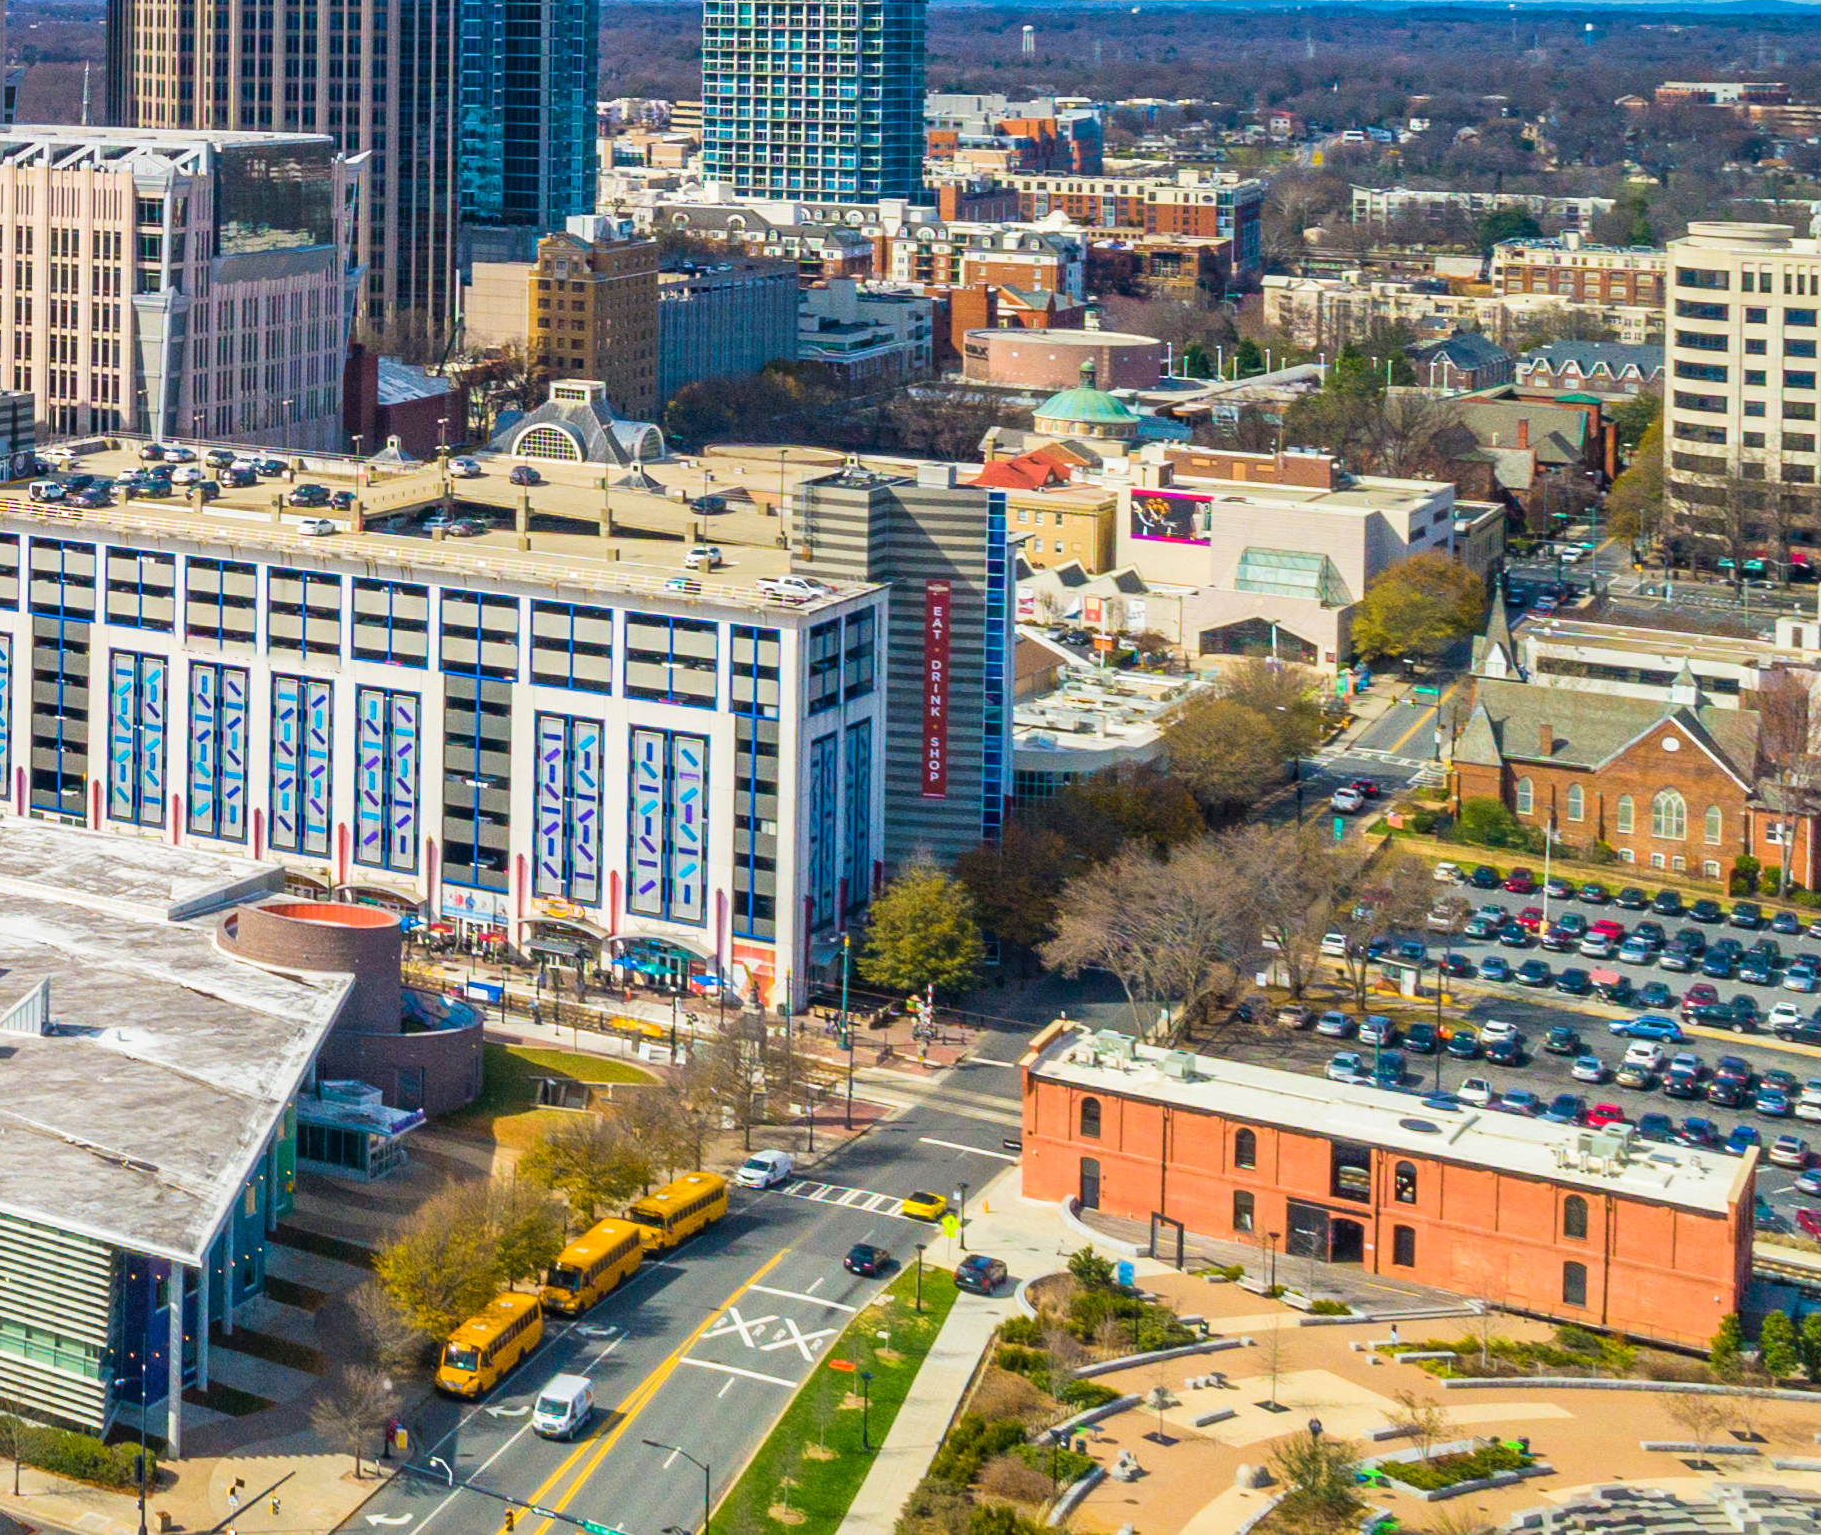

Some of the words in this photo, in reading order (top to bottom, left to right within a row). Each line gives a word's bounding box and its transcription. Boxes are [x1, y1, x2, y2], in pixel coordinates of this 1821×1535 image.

[932, 606, 943, 639] EAT
[930, 659, 942, 717] DRINK
[929, 736, 940, 781] SHOP
